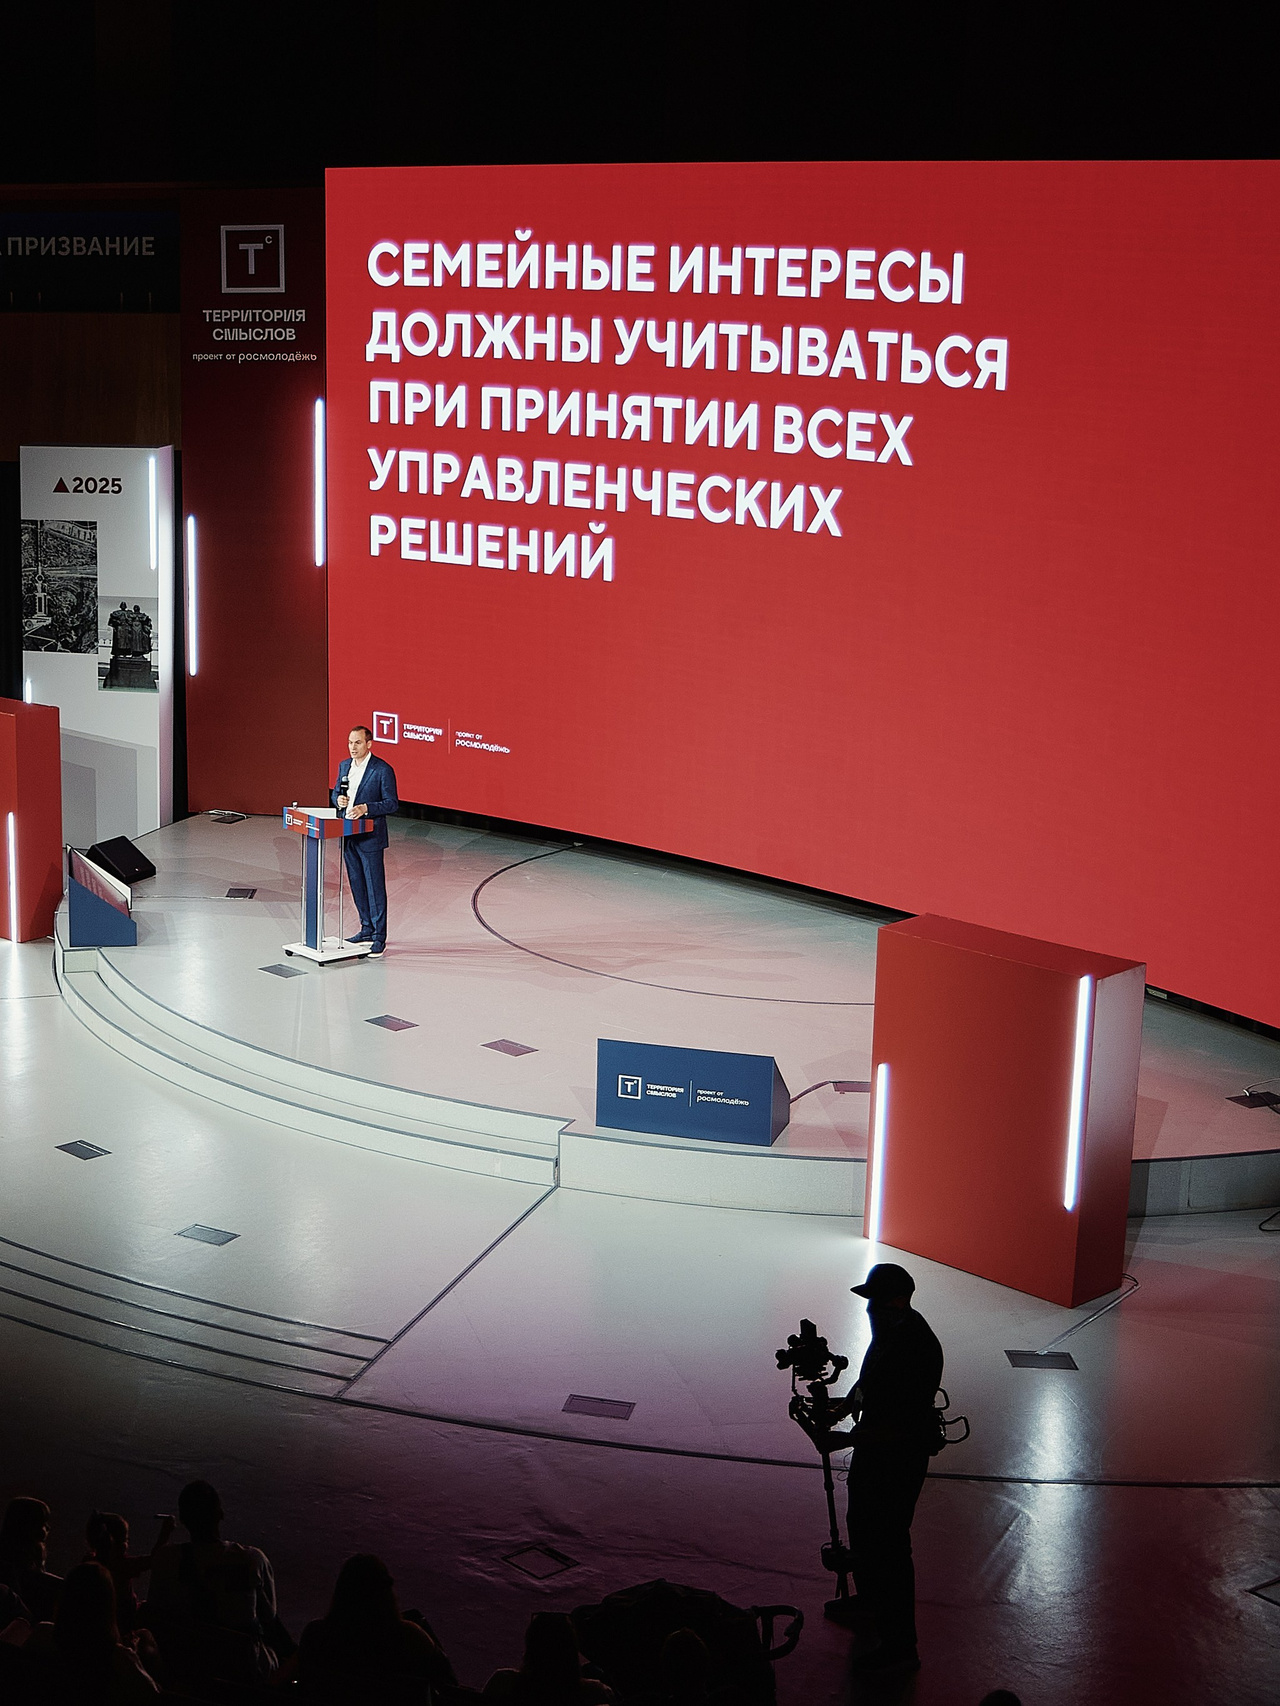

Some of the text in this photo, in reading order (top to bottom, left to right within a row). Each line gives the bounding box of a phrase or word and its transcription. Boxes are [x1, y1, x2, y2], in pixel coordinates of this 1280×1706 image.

[7, 236, 155, 256] ПРИЗВАНИЕ
[367, 229, 964, 305] СЕМЕЙНЫЕ ИНТЕРЕСЫ
[202, 309, 306, 322] ТЕРРИТОРИЯ
[212, 328, 296, 341] СМЫСЛОВ
[192, 351, 318, 364] проект от росмолодёжь
[365, 311, 1008, 391] ДОЛЖНЫ УЧИТЫВАТЬСЯ
[369, 380, 914, 466] ПРИ ПРИНЯТИИ ВСЕХ
[72, 476, 123, 495] 2025
[367, 448, 843, 537] УПРАВЛЕНЧЕСКИХ
[370, 514, 613, 582] РЕШЕНИЙ
